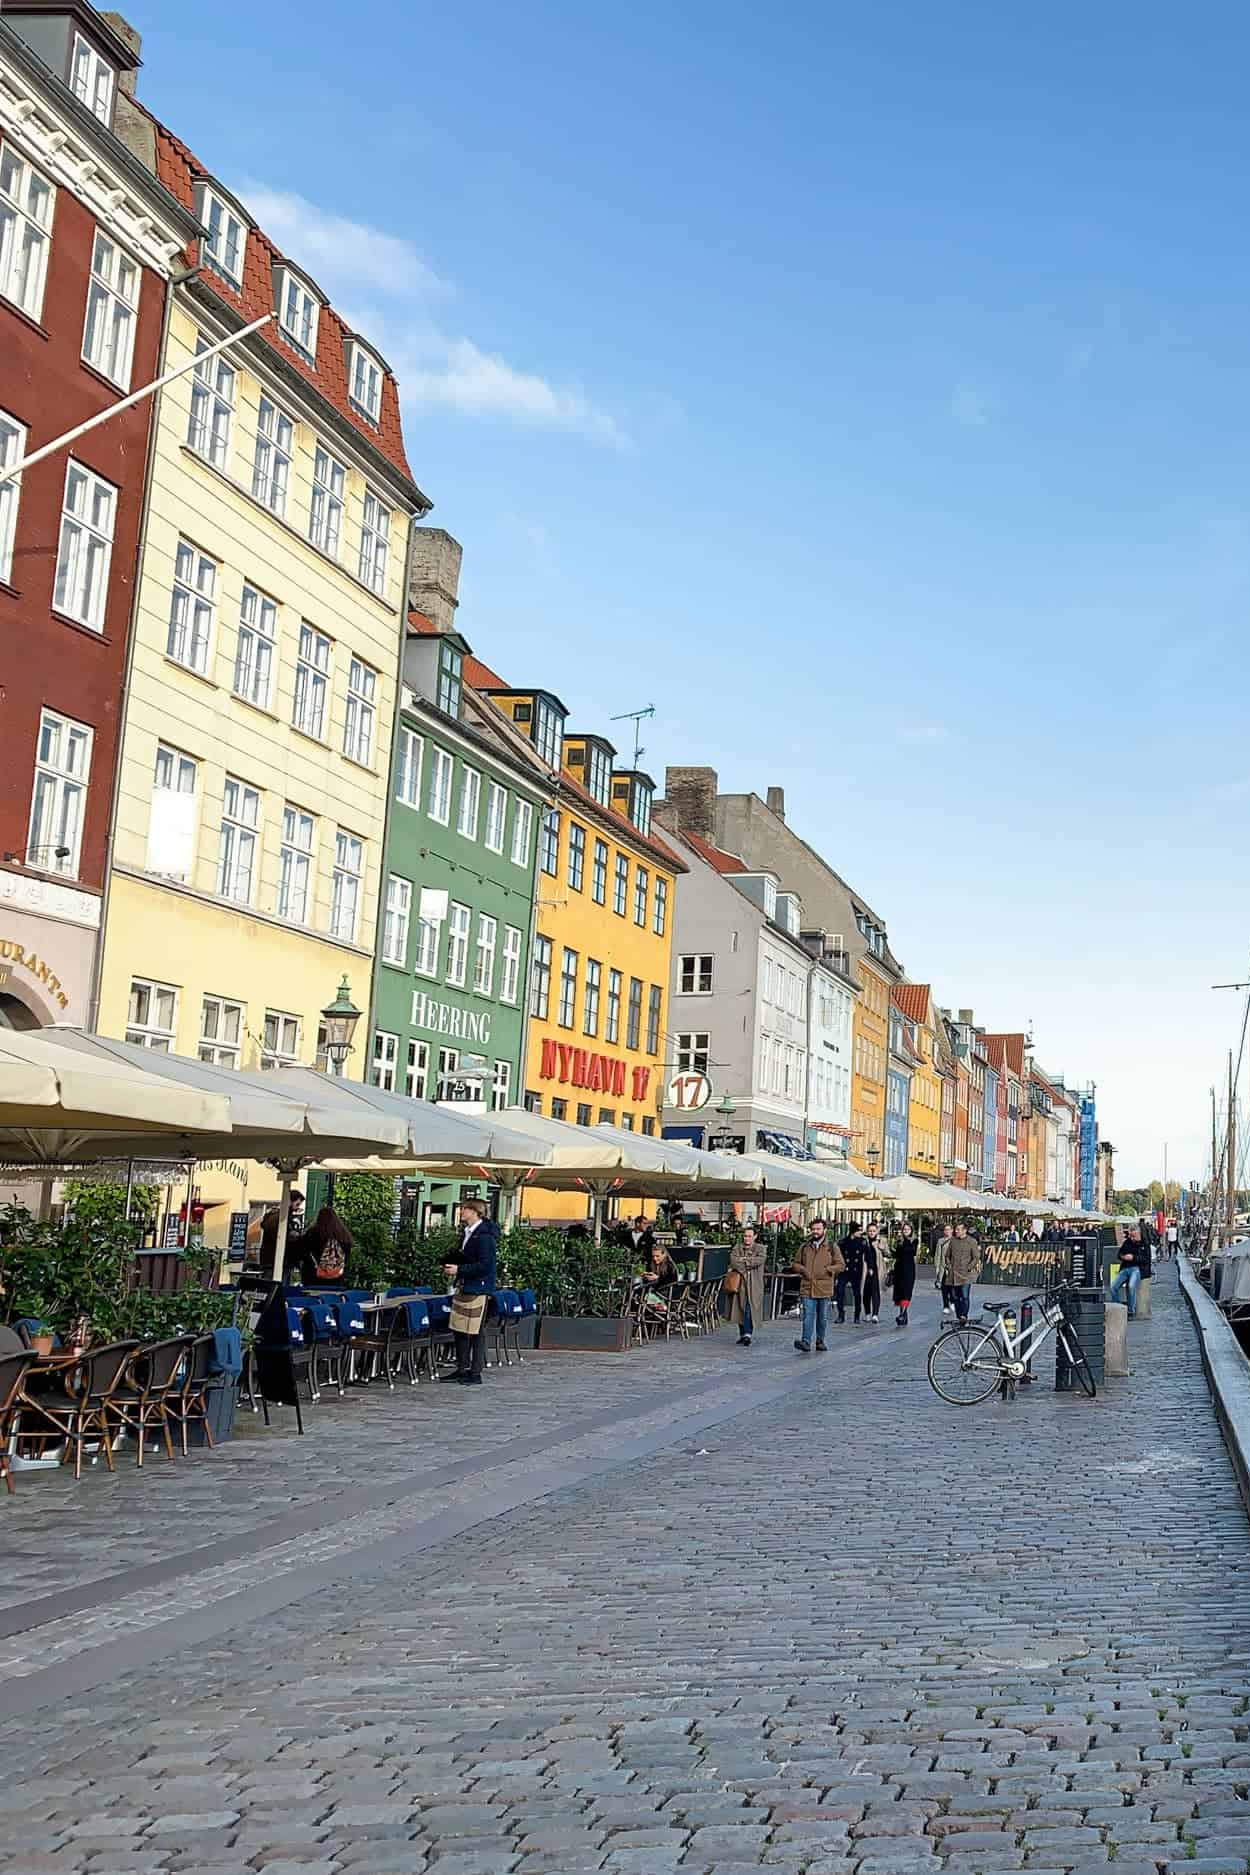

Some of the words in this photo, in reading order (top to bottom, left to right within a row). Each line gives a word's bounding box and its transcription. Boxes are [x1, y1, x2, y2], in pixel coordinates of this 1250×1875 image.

[409, 990, 490, 1044] HEERING
[539, 1038, 627, 1098] NYHAVN
[631, 1066, 650, 1102] 17
[671, 1076, 704, 1108] 17
